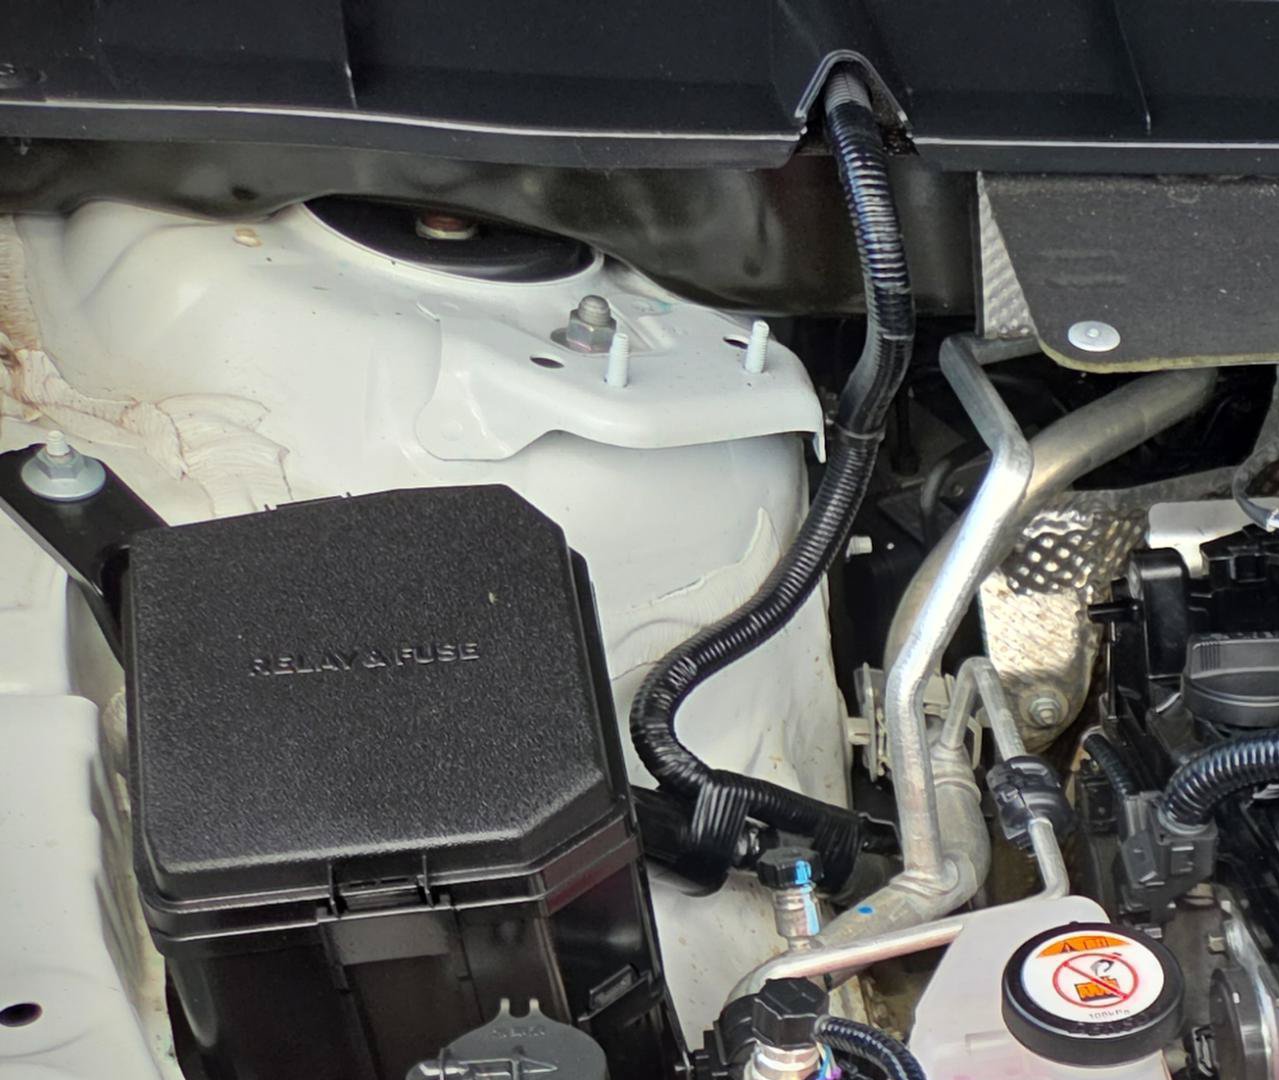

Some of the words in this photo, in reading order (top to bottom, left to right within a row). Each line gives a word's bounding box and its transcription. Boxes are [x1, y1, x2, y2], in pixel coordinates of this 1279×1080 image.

[250, 653, 351, 677] RELAY
[362, 648, 388, 672] &
[396, 643, 481, 667] FUSE
